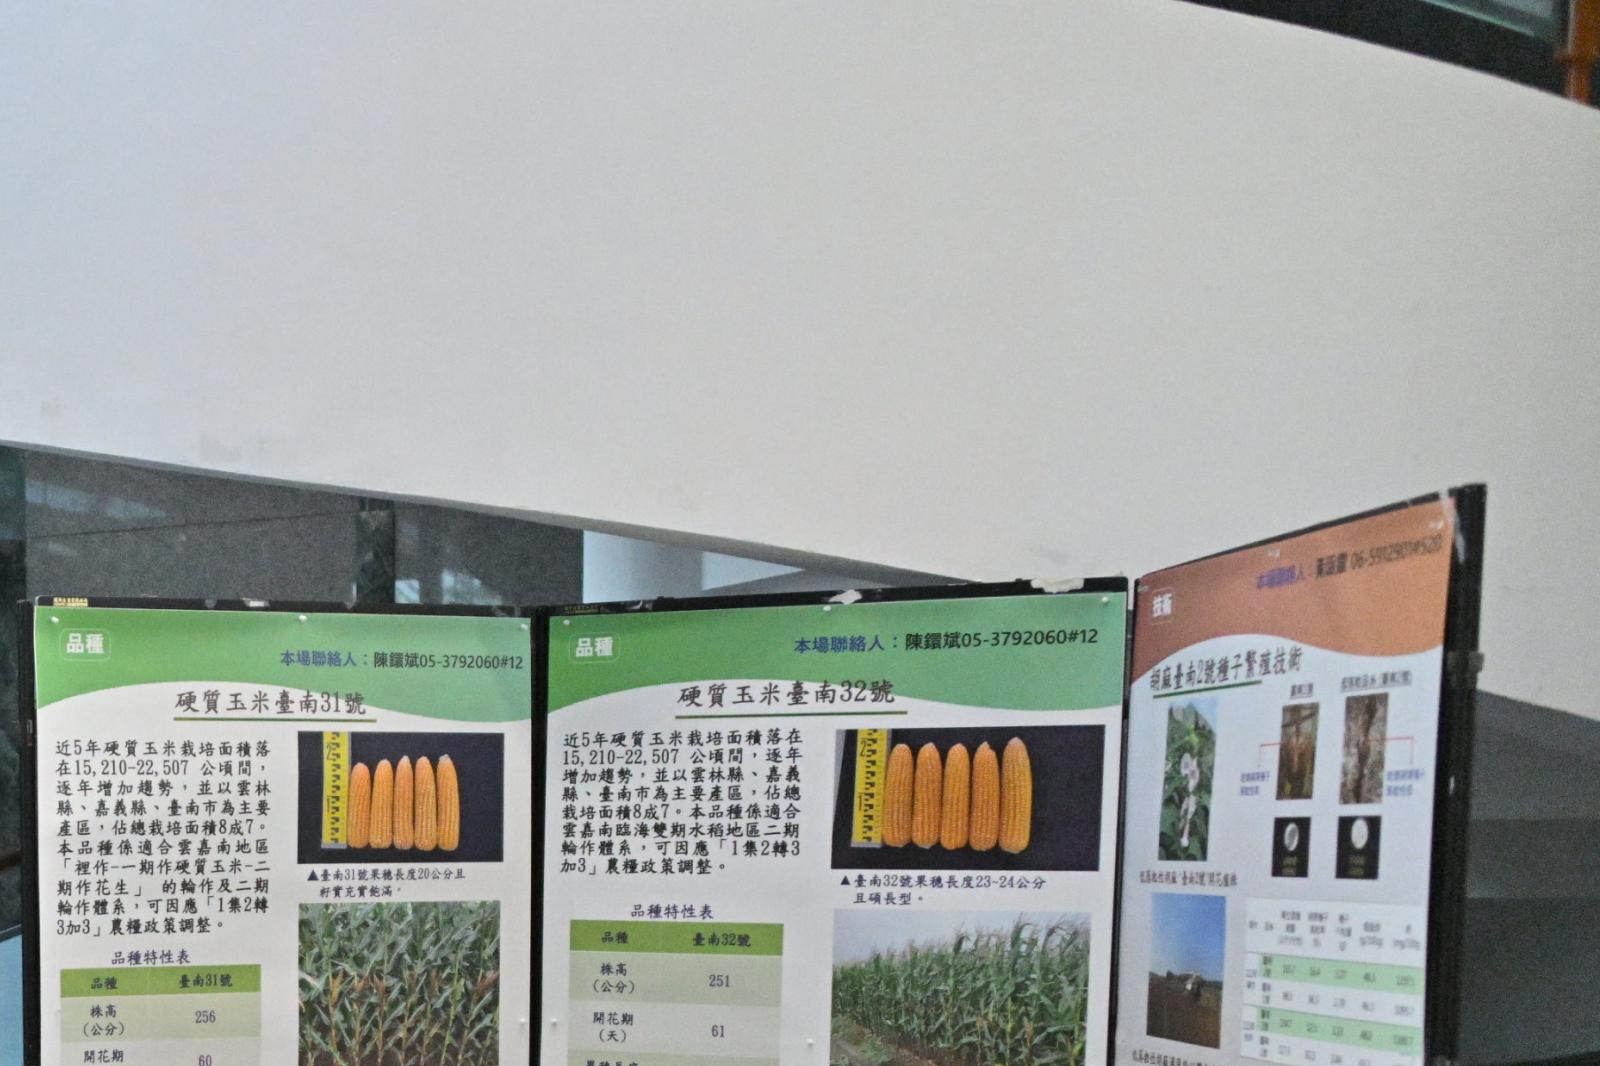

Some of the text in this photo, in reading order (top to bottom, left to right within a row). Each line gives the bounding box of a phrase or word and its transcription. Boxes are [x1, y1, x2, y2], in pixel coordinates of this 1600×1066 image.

[66, 634, 105, 655] 品種
[576, 637, 614, 658] 品種
[676, 678, 895, 708] 硬質玉米臺南32號
[175, 690, 367, 716] 硬質玉米臺南31號
[563, 727, 804, 748] 近5年硬質玉米栽培面積落在
[56, 739, 271, 758] 近5年硬質玉米栽培面積落
[563, 746, 804, 767] 15,210-22,507 公頃間，逐年
[55, 759, 266, 777] 在15,210-22,507 公頃間，
[562, 764, 801, 785] 增加趨勢，並以雲林縣、嘉義
[56, 779, 271, 797] 逐年增加趨勢，並以雲林
[561, 784, 802, 802] 縣、臺南市為主要產區，佔總
[56, 799, 271, 816] 縣、嘉義縣、臺南市為主要
[562, 803, 801, 821] 栽培面積8成7。本品種係適合
[56, 818, 266, 837] 產區，佔總栽培面積8成7。
[562, 822, 800, 840] 雲嘉南臨海雙期水稻地區二期
[56, 838, 270, 856] 本品種係適合雲嘉南地區
[561, 838, 801, 858] 輪作體系，可因應「1集2轉3
[560, 857, 726, 876] 加3」農糧政策調整。
[56, 878, 270, 897] 期作花生」 的輪作及二期
[56, 896, 270, 916] 輪作體系，可因應「1集2轉
[630, 903, 714, 920] 品種特性表
[56, 917, 224, 937] 3加3」農糧政策調整。
[601, 931, 752, 948] 品種 臺南32號
[111, 948, 191, 966] 品種特性表
[91, 973, 233, 990] 品種 臺南31號
[600, 962, 731, 988] 株高 251
[592, 980, 636, 995] (公分)
[90, 1004, 216, 1024] 株高 256
[83, 1022, 125, 1038] (公分)
[592, 1011, 725, 1039] 開花期 61
[598, 1028, 627, 1043] (天)
[84, 1050, 124, 1064] 開花期
